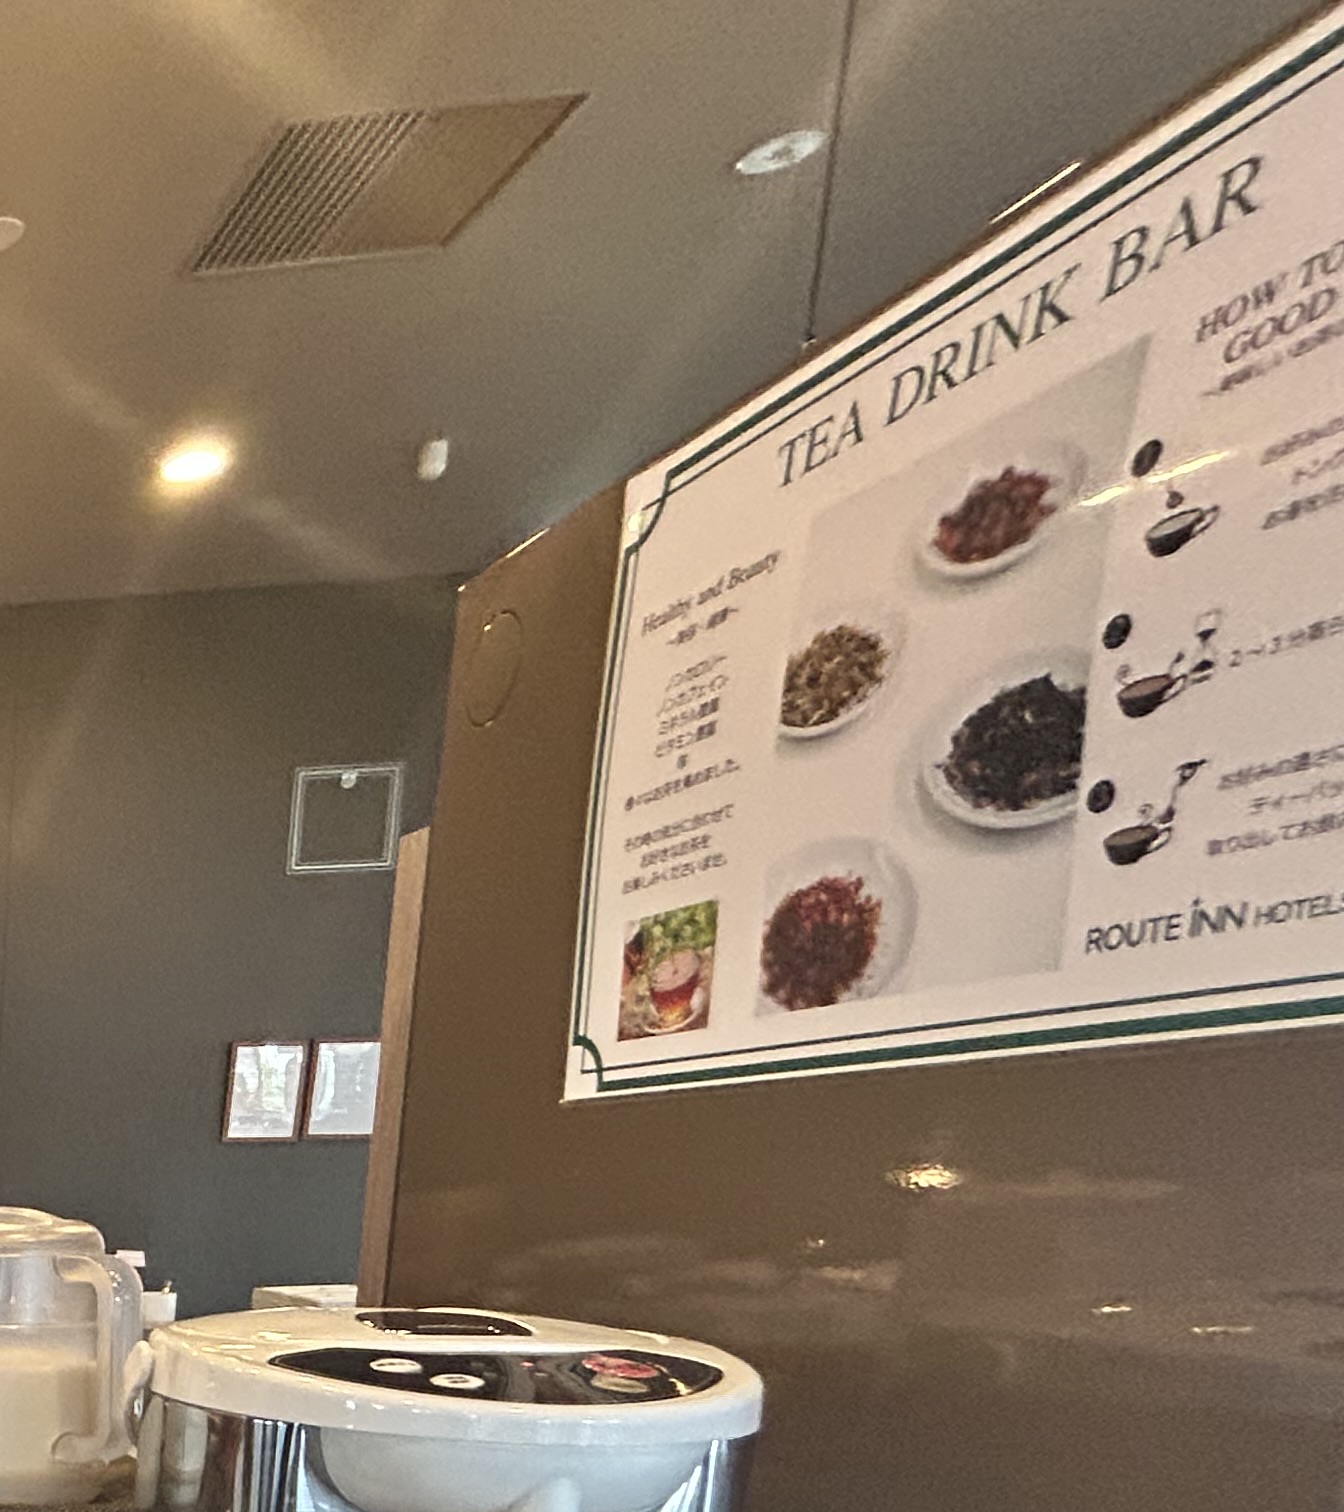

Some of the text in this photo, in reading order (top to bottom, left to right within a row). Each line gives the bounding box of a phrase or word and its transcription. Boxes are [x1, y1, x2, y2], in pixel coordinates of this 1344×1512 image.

[778, 399, 865, 488] TEA
[882, 262, 1083, 427] DRINK
[1099, 153, 1265, 303] BAR
[1195, 271, 1291, 344] HOW
[1223, 287, 1337, 364] GOOD
[1085, 912, 1183, 955] ROUTE
